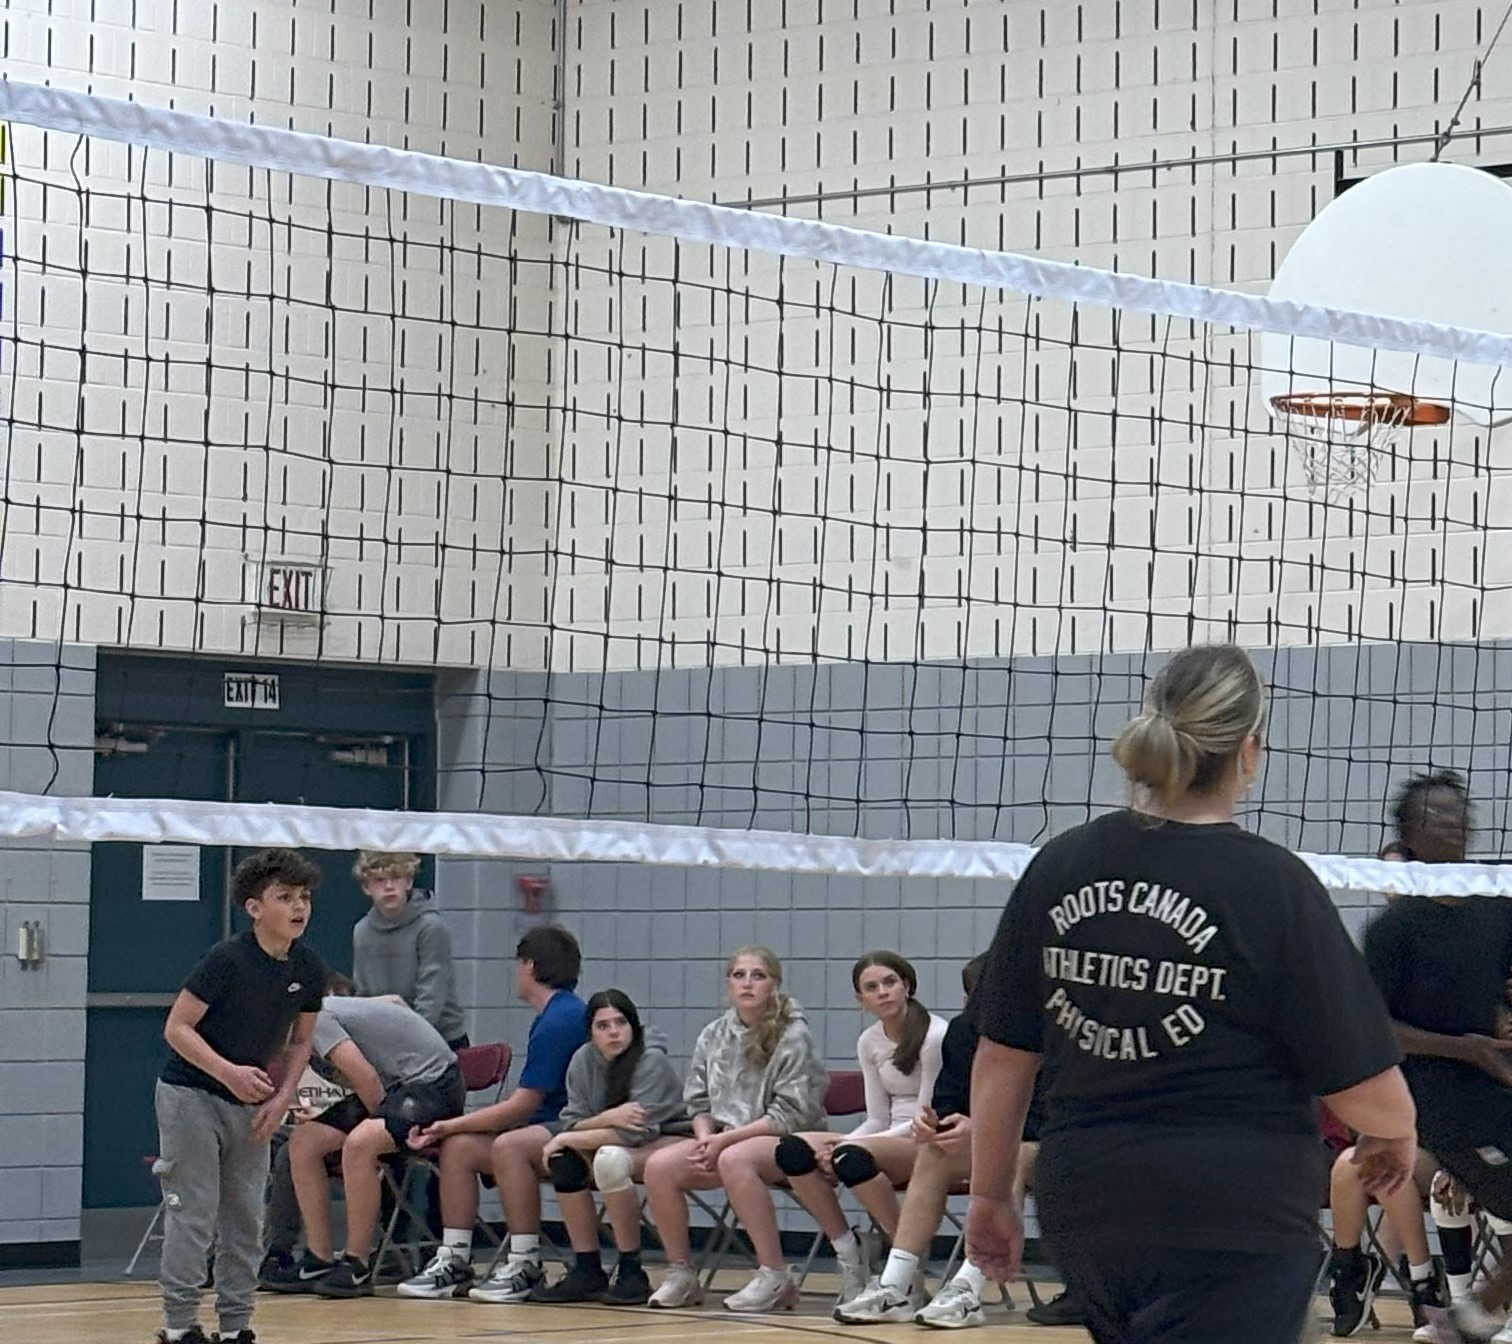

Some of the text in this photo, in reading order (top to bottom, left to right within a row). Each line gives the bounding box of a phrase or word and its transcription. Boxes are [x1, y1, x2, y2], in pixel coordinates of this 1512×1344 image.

[269, 567, 313, 610] EXIT
[226, 676, 257, 704] EXIT
[1048, 880, 1218, 955] ROOTS CANADA
[1154, 960, 1227, 1001] DEPT.
[1161, 1003, 1206, 1047] ED
